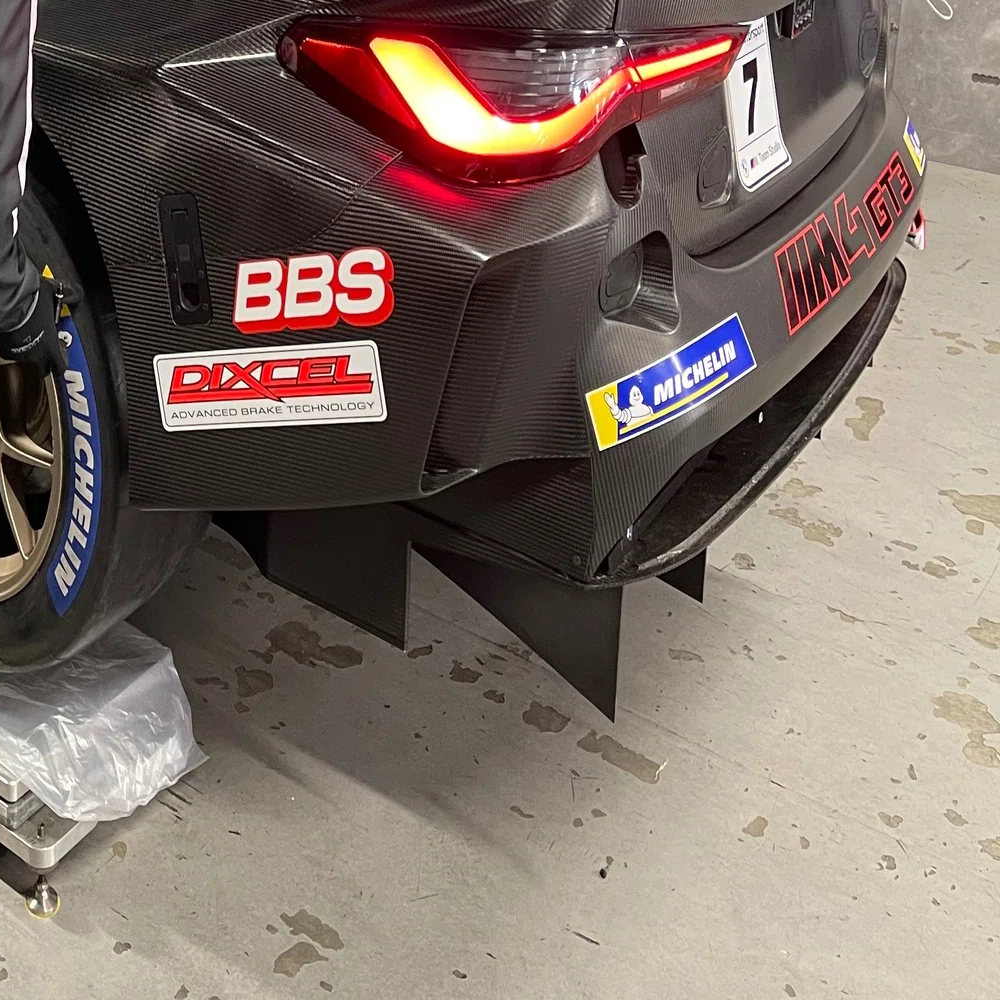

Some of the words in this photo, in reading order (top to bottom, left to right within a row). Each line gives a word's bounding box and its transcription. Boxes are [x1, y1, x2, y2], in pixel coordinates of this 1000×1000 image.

[742, 57, 758, 136] 7
[863, 151, 915, 243] GT3
[233, 247, 393, 333] BBS
[168, 355, 373, 403] DIXCEL
[171, 407, 238, 420] ADVANCED
[241, 405, 283, 416] BRAKE
[286, 402, 376, 414] TECHNOLOGY
[653, 340, 738, 406] MICHELIN
[53, 369, 95, 597] MICHELIN
